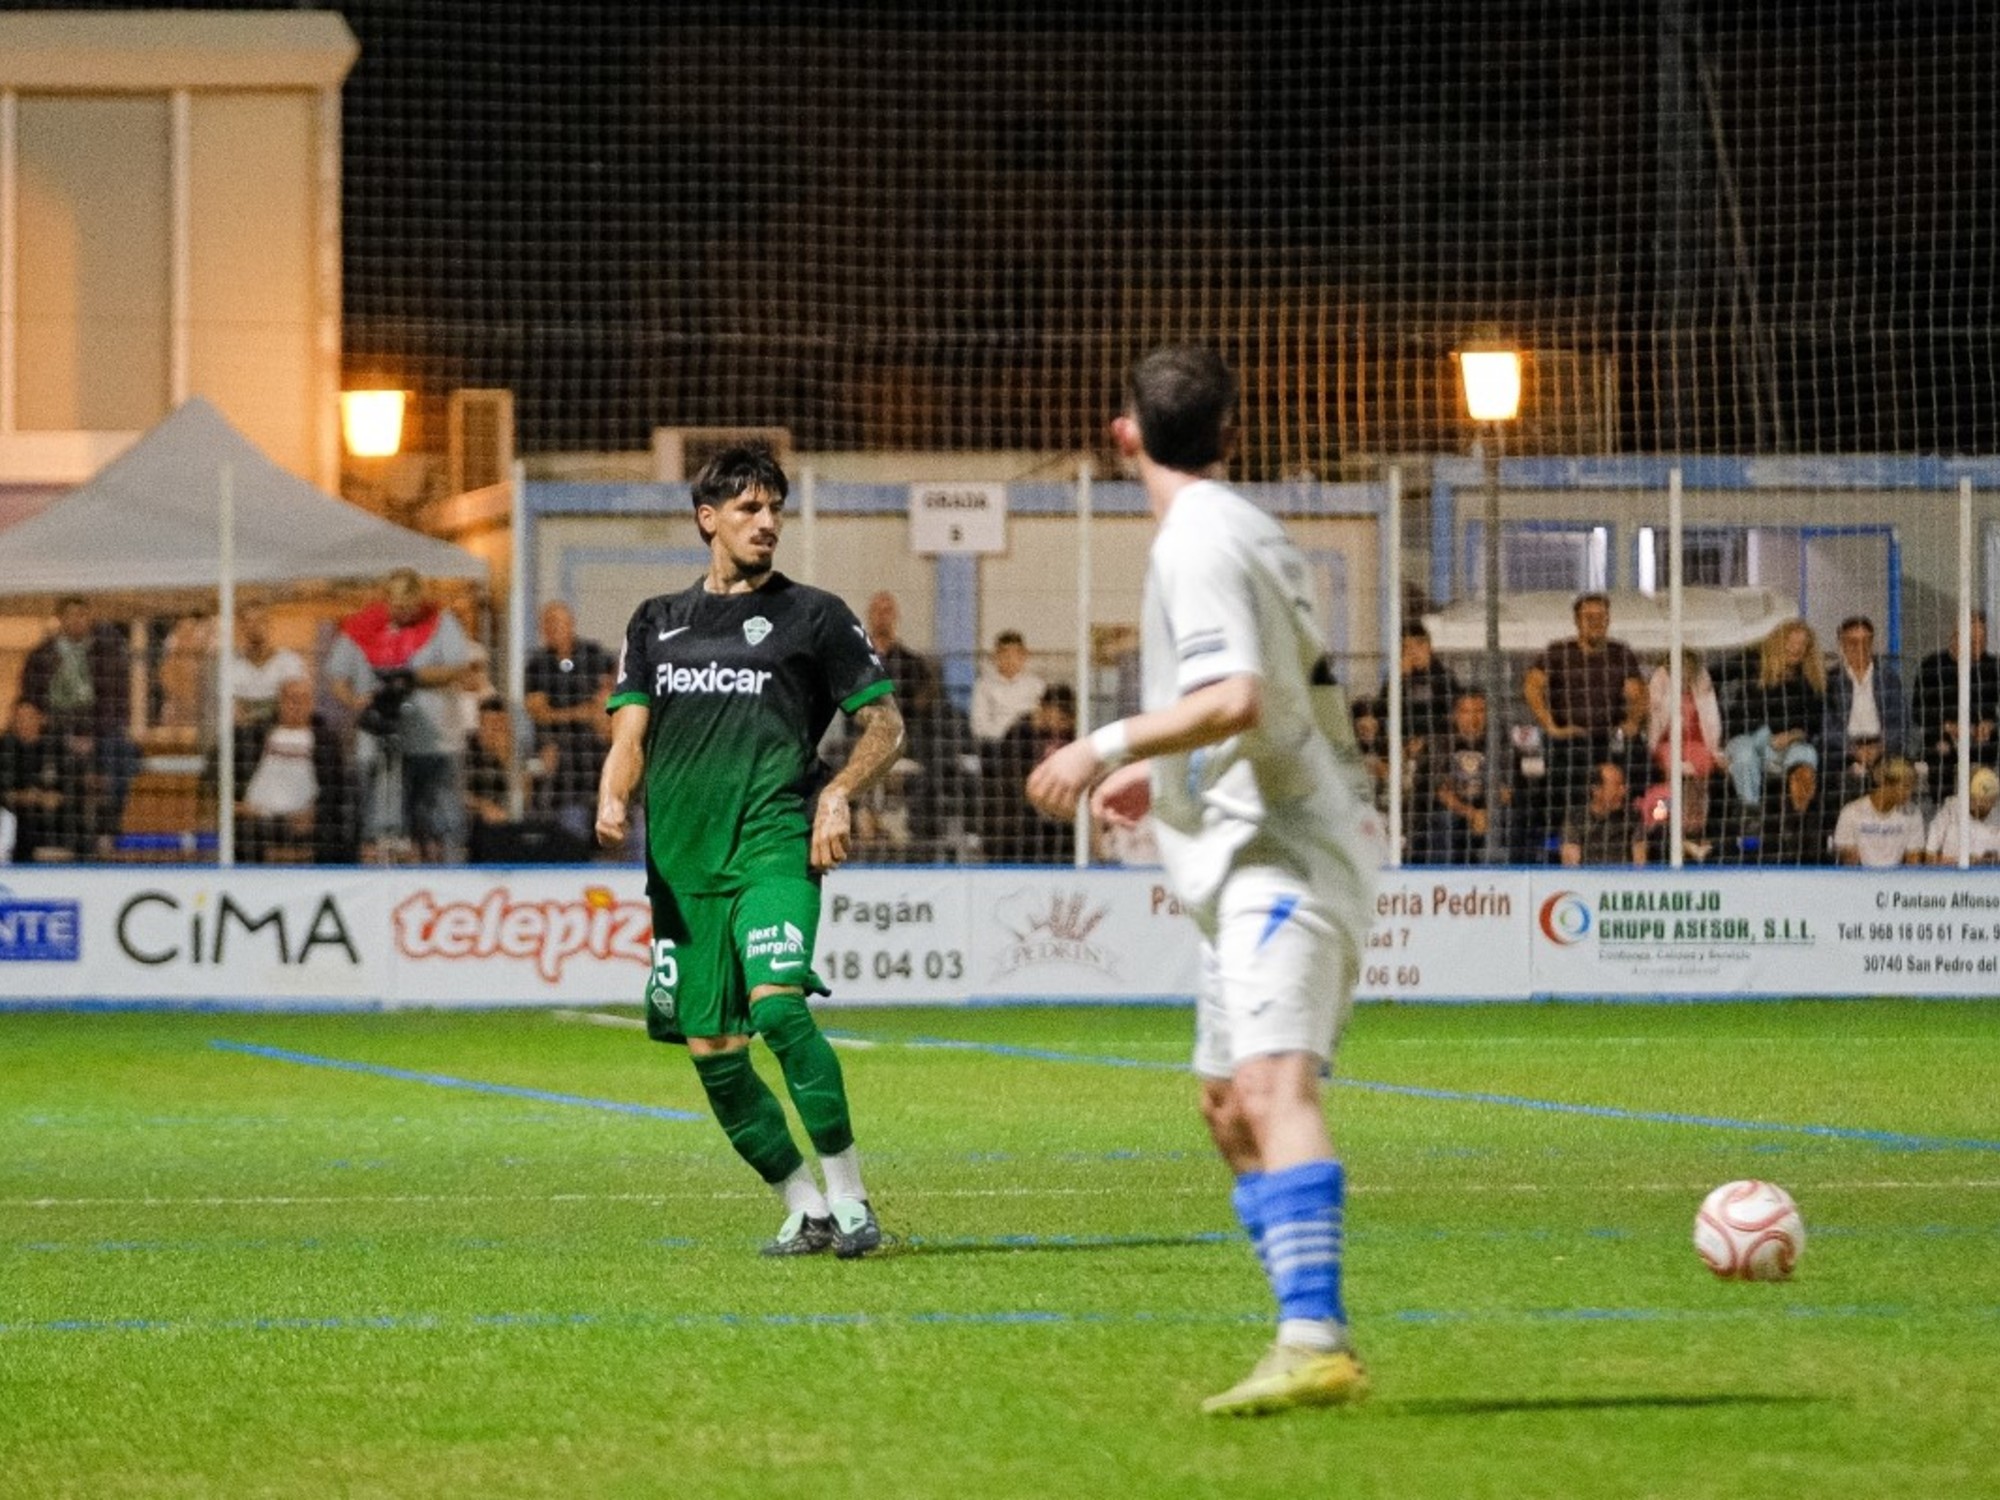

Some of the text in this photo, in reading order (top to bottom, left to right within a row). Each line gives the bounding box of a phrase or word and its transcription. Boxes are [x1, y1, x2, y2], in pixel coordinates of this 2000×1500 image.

[656, 660, 773, 697] Flexicar
[1599, 891, 1721, 912] ALBALADEJO
[1893, 890, 1946, 908] Pantano
[1951, 890, 2000, 908] Alfonso
[748, 925, 779, 941] Next
[1401, 928, 1410, 947] 7
[1599, 919, 1665, 940] GRUPO
[1673, 919, 1756, 944] ASESOR,
[824, 951, 963, 979] 18 04 03
[1864, 955, 1997, 972] 30740 San Pedro del
[1365, 965, 1421, 986] 06 60
